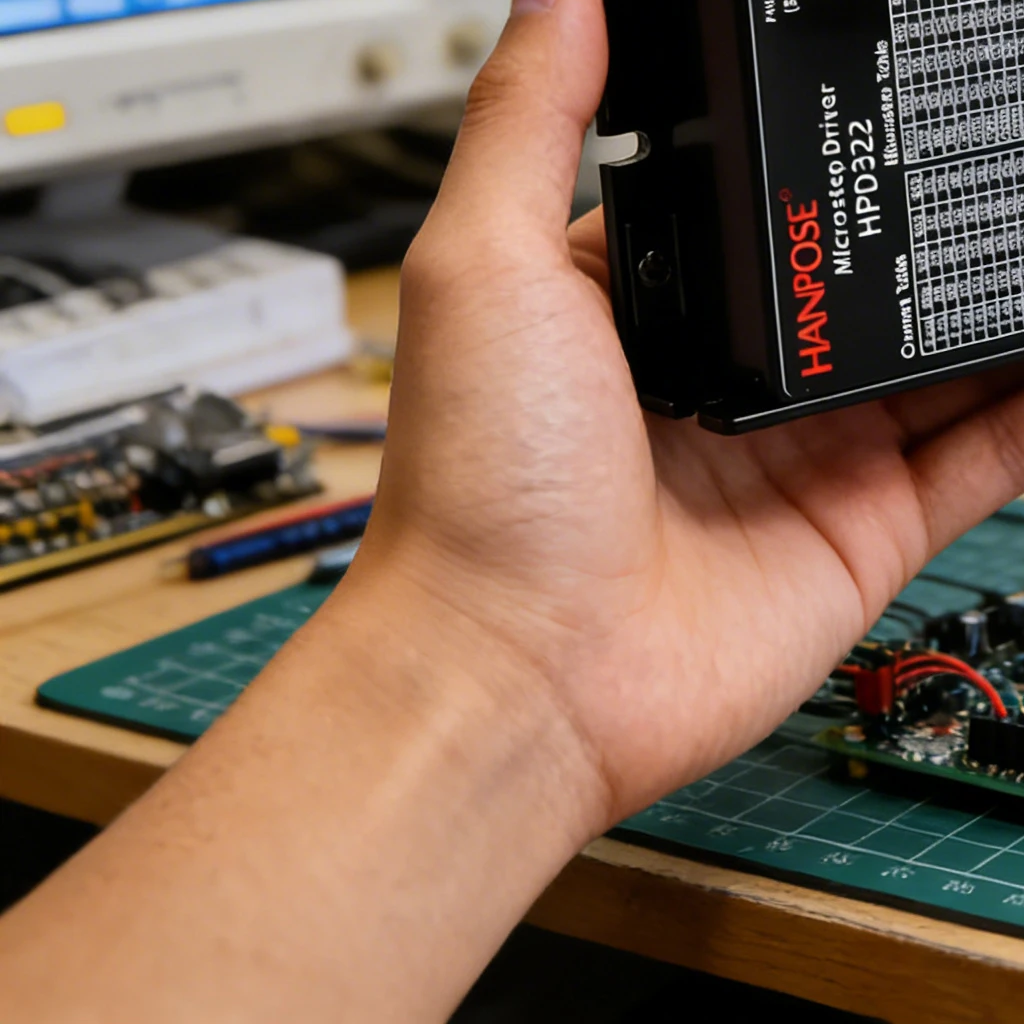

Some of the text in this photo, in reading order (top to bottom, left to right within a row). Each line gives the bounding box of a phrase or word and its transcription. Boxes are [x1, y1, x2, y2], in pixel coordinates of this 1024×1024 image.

[819, 84, 840, 155] Driver
[849, 119, 881, 237] HPD322
[787, 200, 832, 377] HANPOSE
